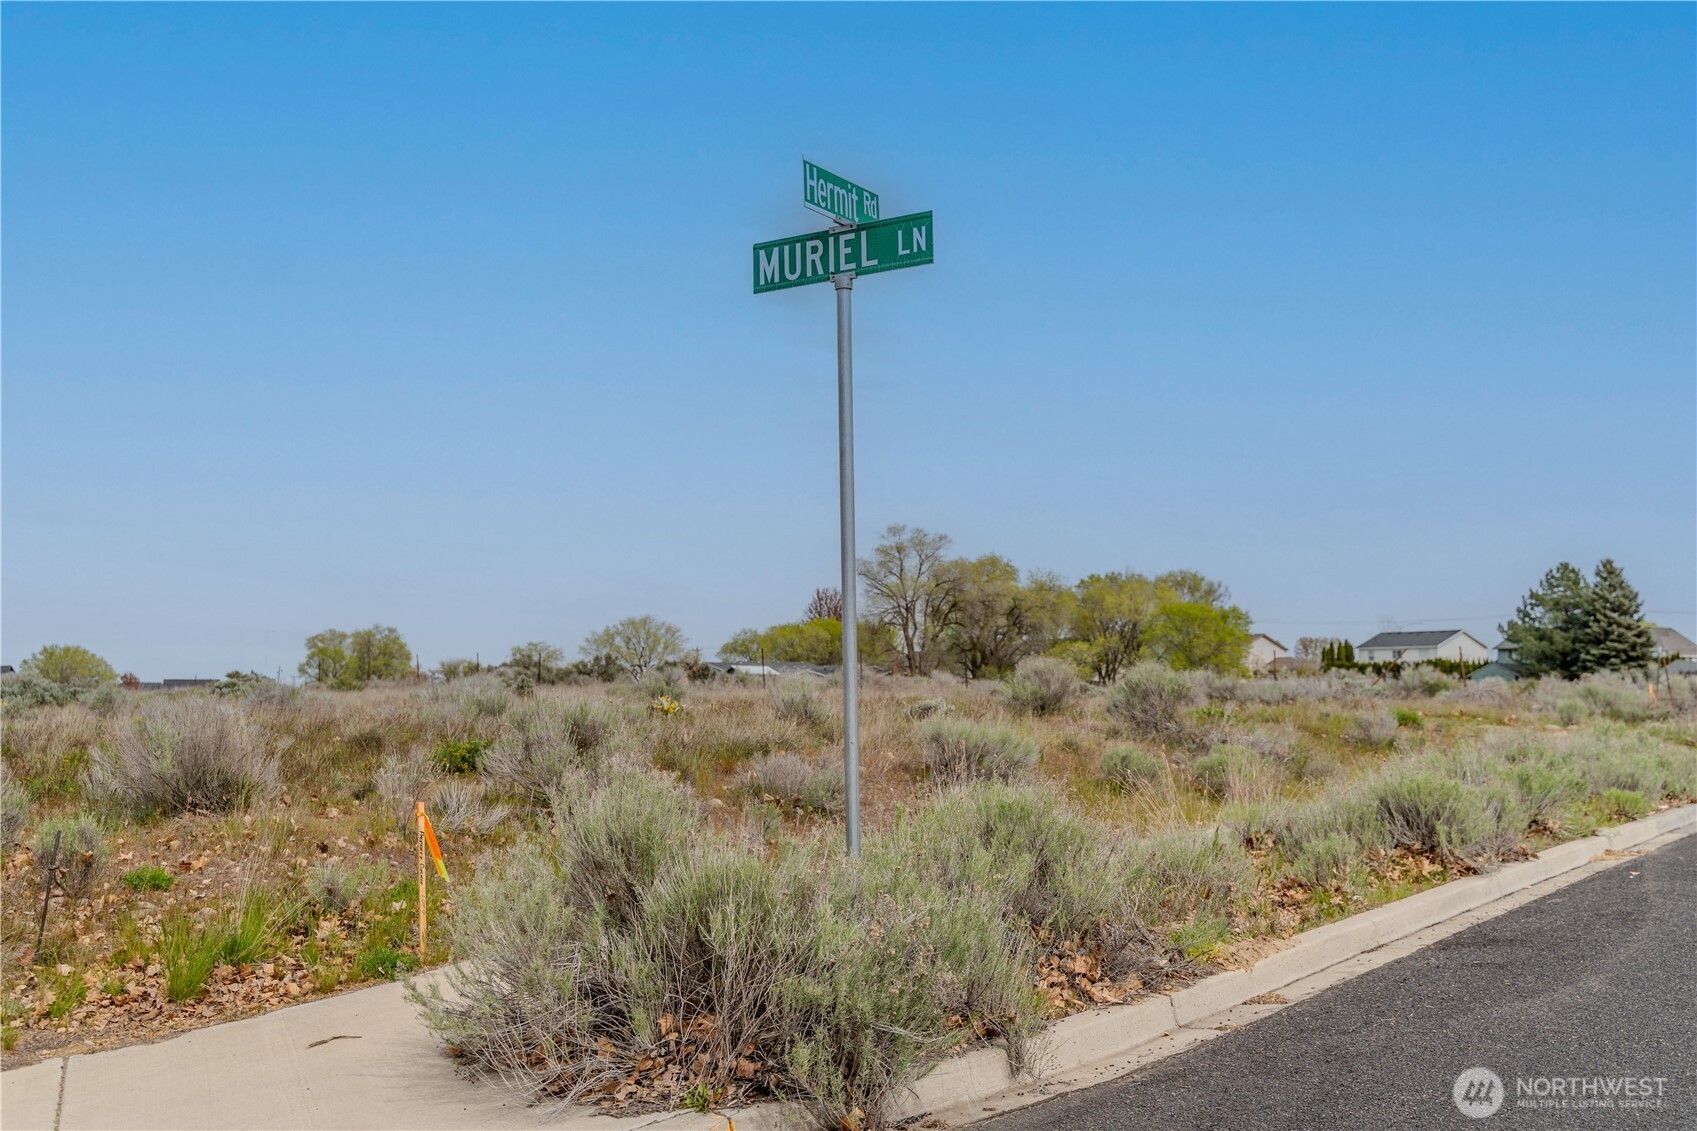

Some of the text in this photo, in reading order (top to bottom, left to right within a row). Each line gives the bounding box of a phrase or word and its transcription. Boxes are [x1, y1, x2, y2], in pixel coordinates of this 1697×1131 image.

[805, 163, 877, 223] Hermit Rd
[759, 225, 927, 286] MURIEL LN
